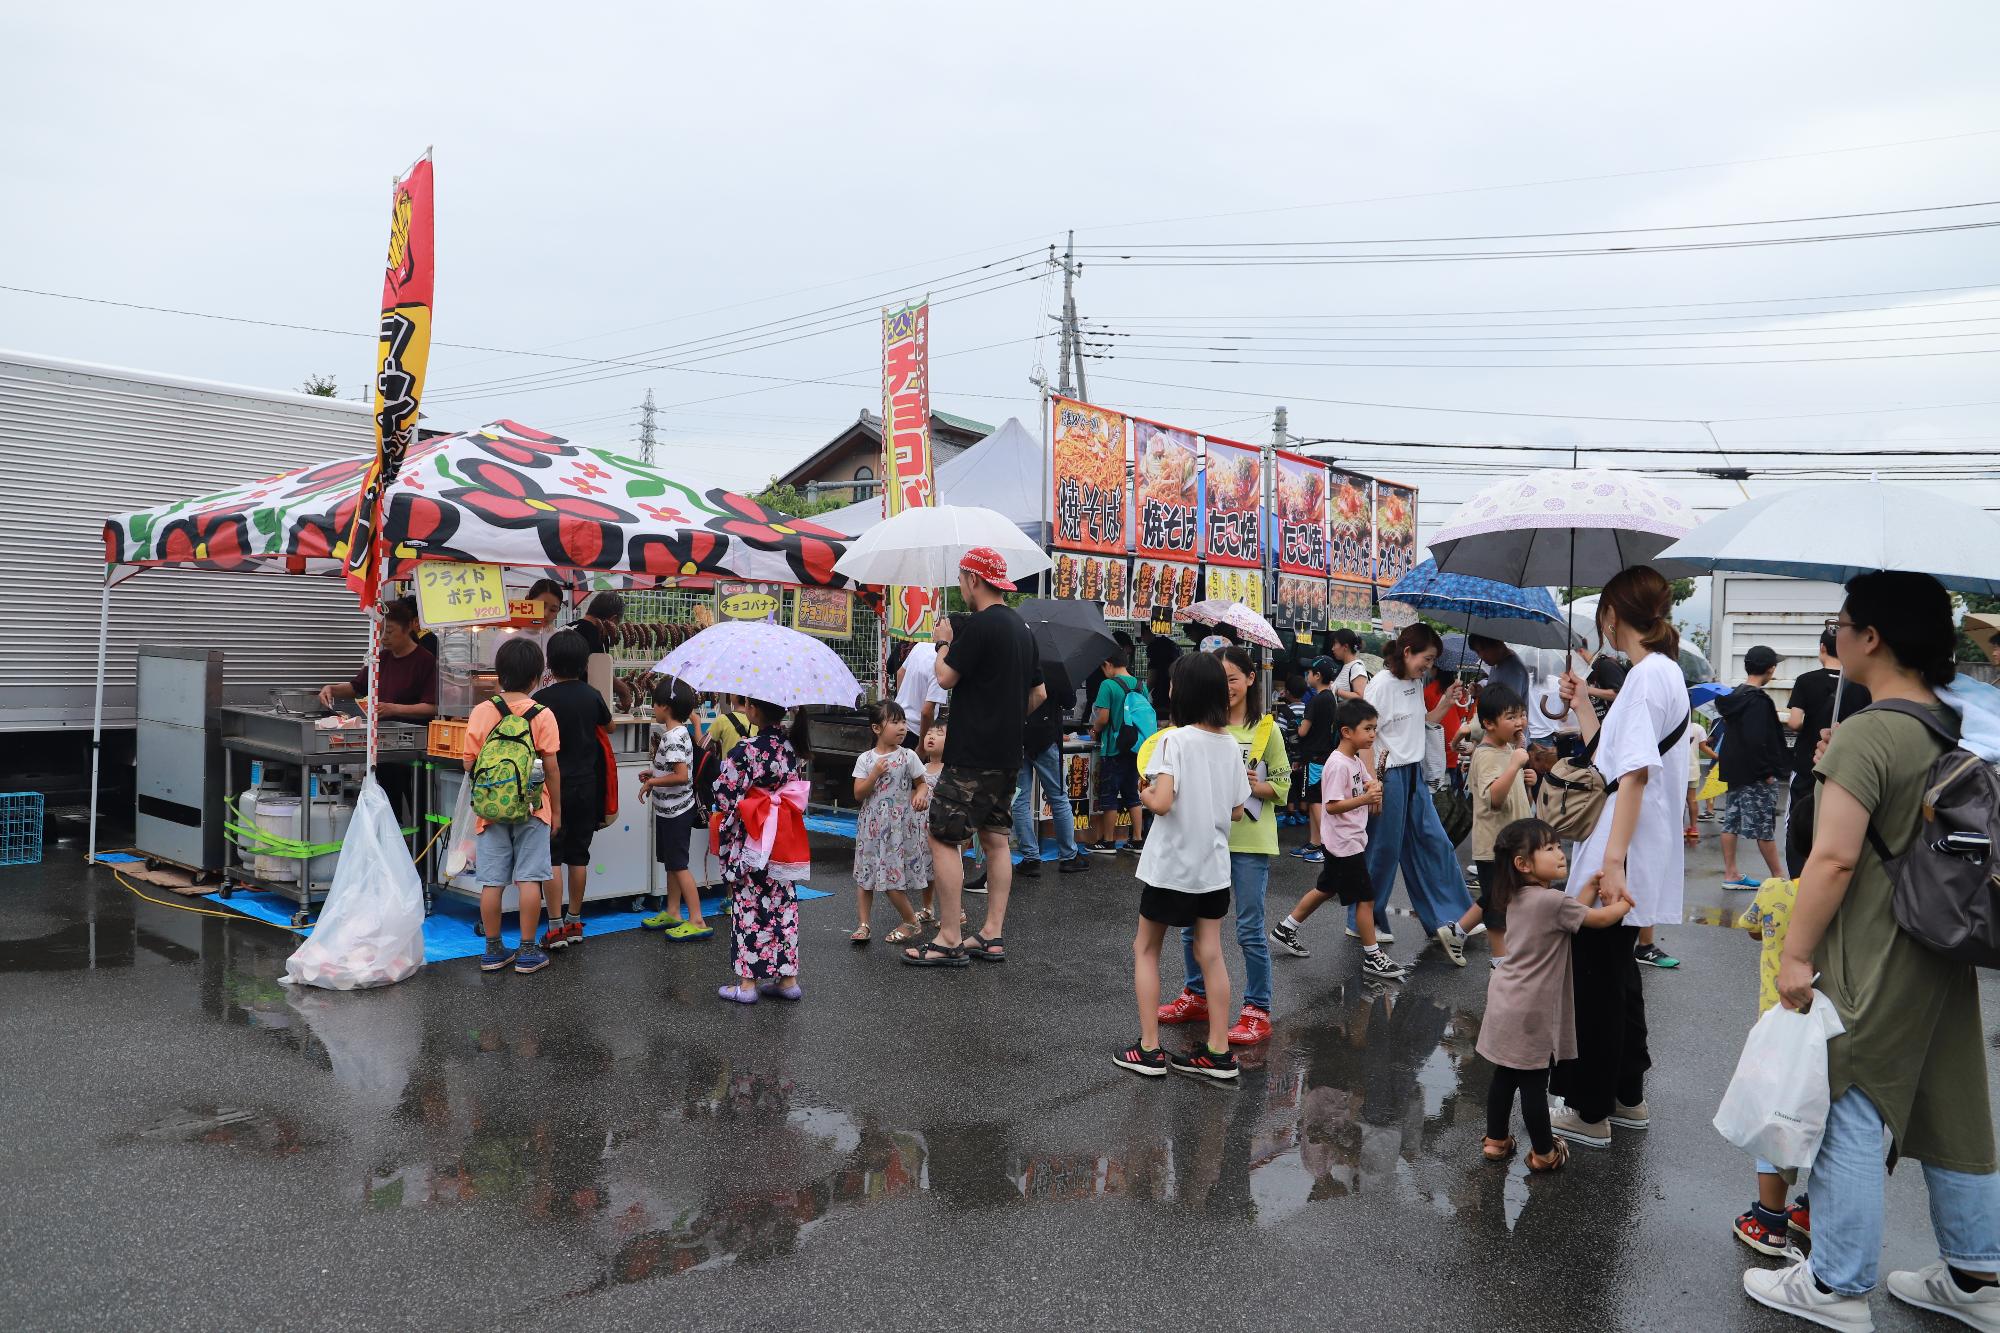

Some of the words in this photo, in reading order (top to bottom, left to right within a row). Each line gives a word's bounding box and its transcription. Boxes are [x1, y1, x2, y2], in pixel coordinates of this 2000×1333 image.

[1057, 476, 1122, 544] 焼そば
[1141, 496, 1198, 552] 焼そば
[1207, 507, 1258, 561] たこ焼
[1281, 519, 1325, 570] たこ焼
[424, 567, 486, 587] フライド
[447, 587, 493, 606] ポテト
[721, 599, 778, 612] チョコバナナ
[799, 599, 848, 625] チョコバナナ
